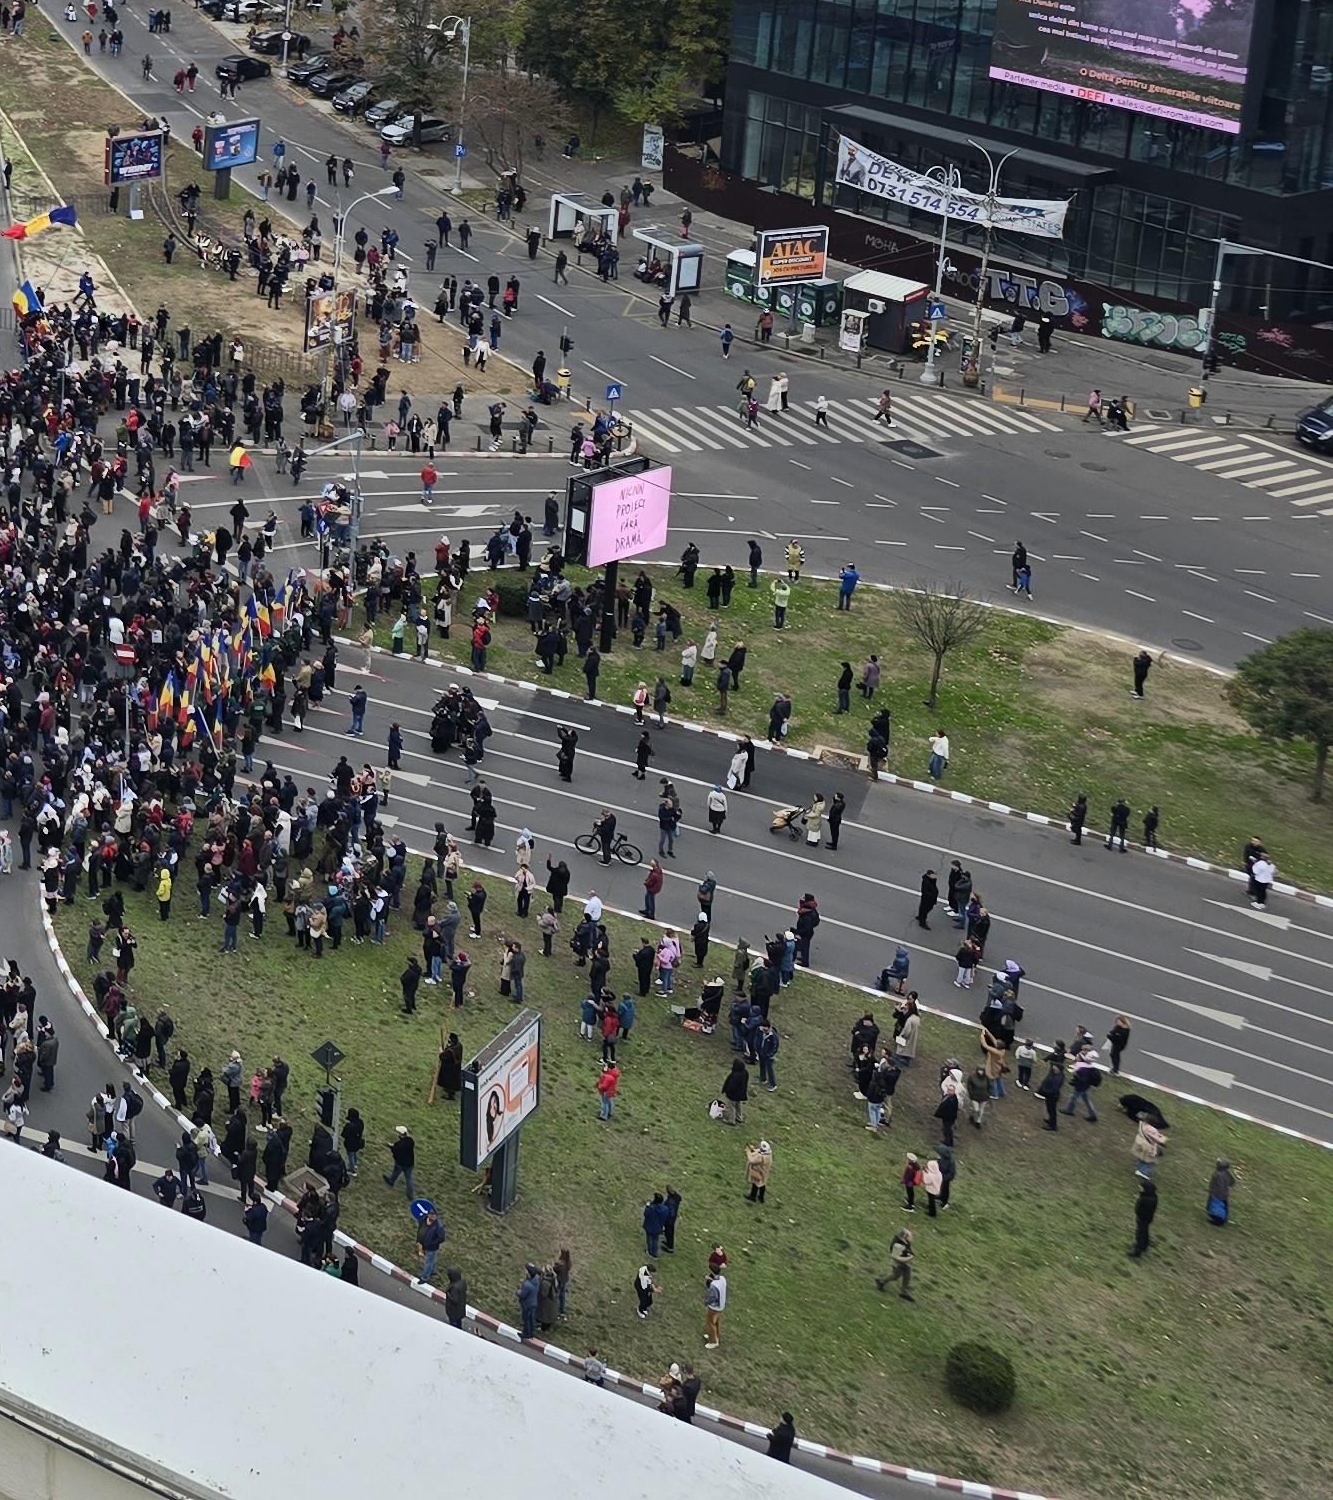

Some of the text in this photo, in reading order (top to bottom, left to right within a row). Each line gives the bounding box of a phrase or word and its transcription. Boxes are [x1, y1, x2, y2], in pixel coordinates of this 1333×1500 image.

[1051, 28, 1065, 36] mai
[1123, 30, 1137, 38] mai
[1204, 47, 1217, 55] din
[1004, 72, 1037, 85] Partener
[1040, 80, 1066, 92] media
[1077, 88, 1105, 101] DEFI
[1079, 67, 1088, 75] O
[1116, 76, 1148, 90] pentru
[1202, 94, 1242, 109] viitoare
[867, 177, 907, 201] 0731
[908, 191, 942, 211] 514
[946, 202, 980, 220] 554
[771, 239, 817, 259] ATAC
